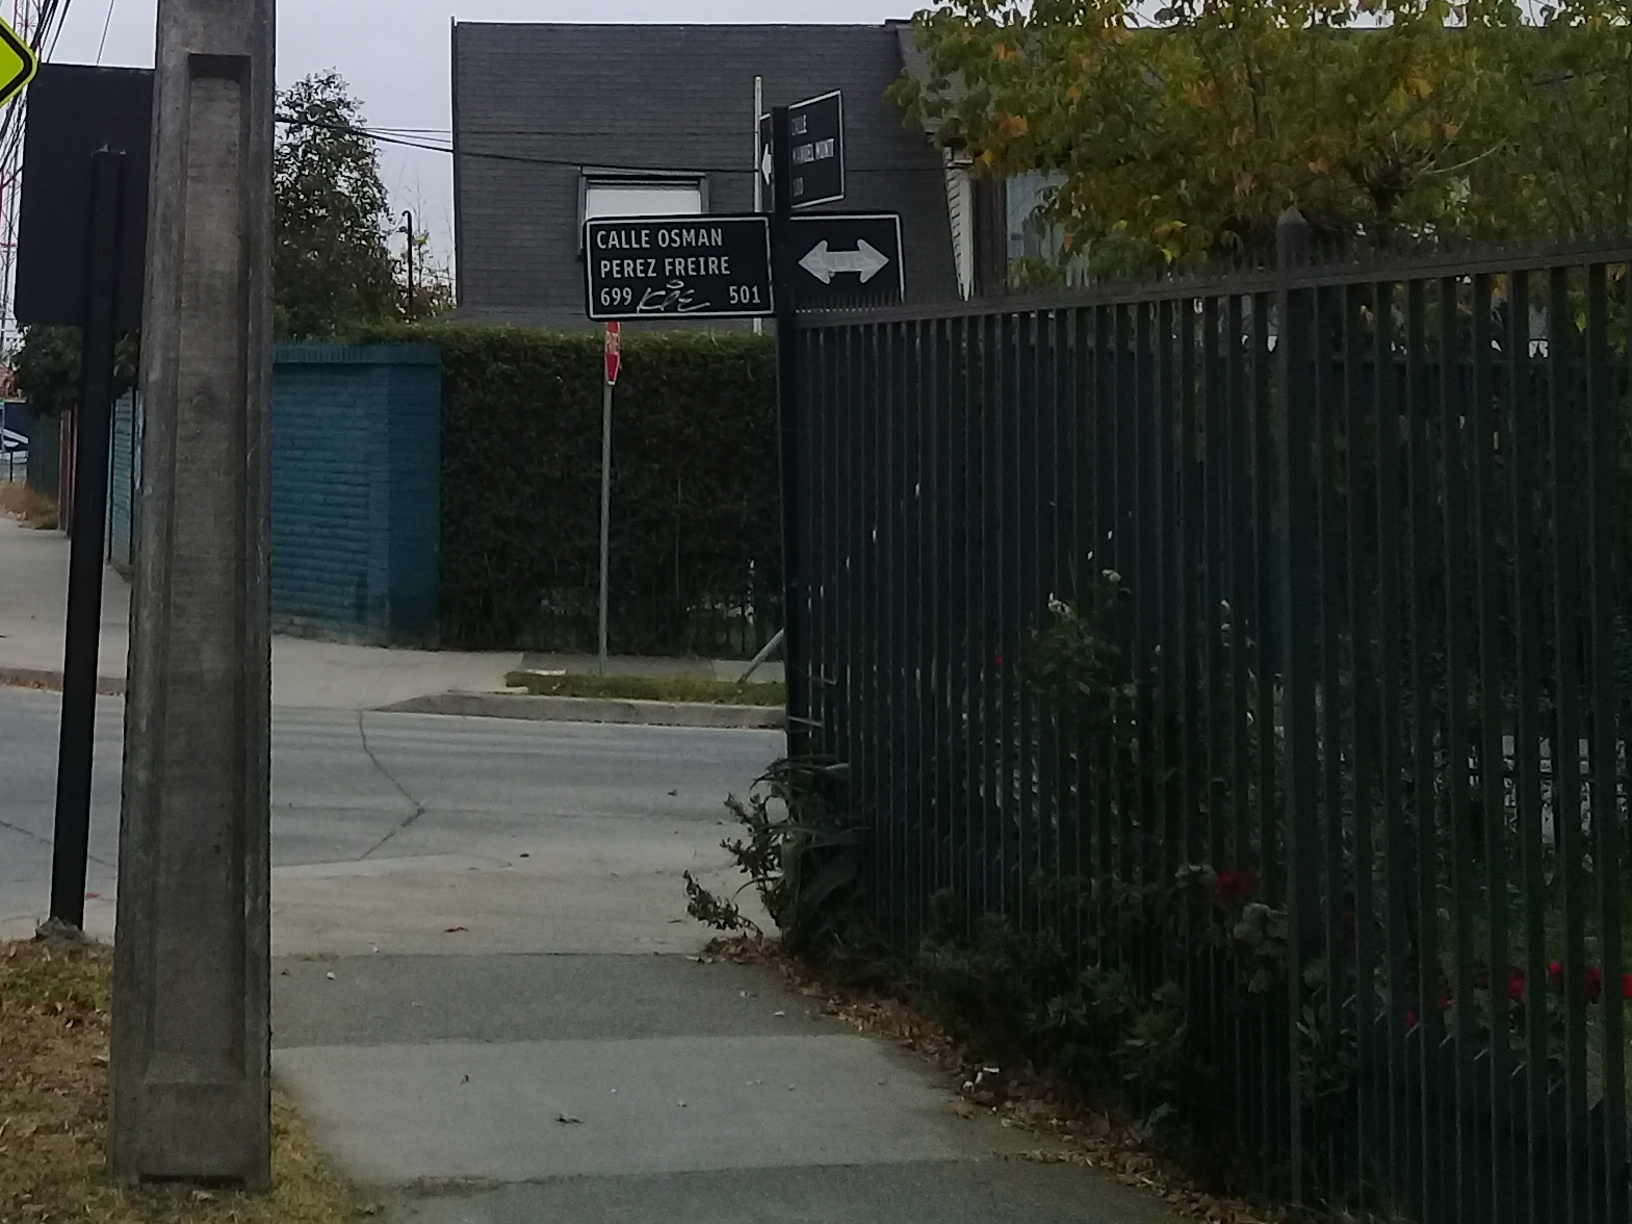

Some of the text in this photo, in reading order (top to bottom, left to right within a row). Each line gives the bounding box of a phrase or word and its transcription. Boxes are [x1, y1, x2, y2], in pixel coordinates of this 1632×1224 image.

[597, 228, 723, 249] CALLE OSMAN
[600, 256, 731, 279] PEREZ FREIRE
[600, 285, 761, 306] 699 501
